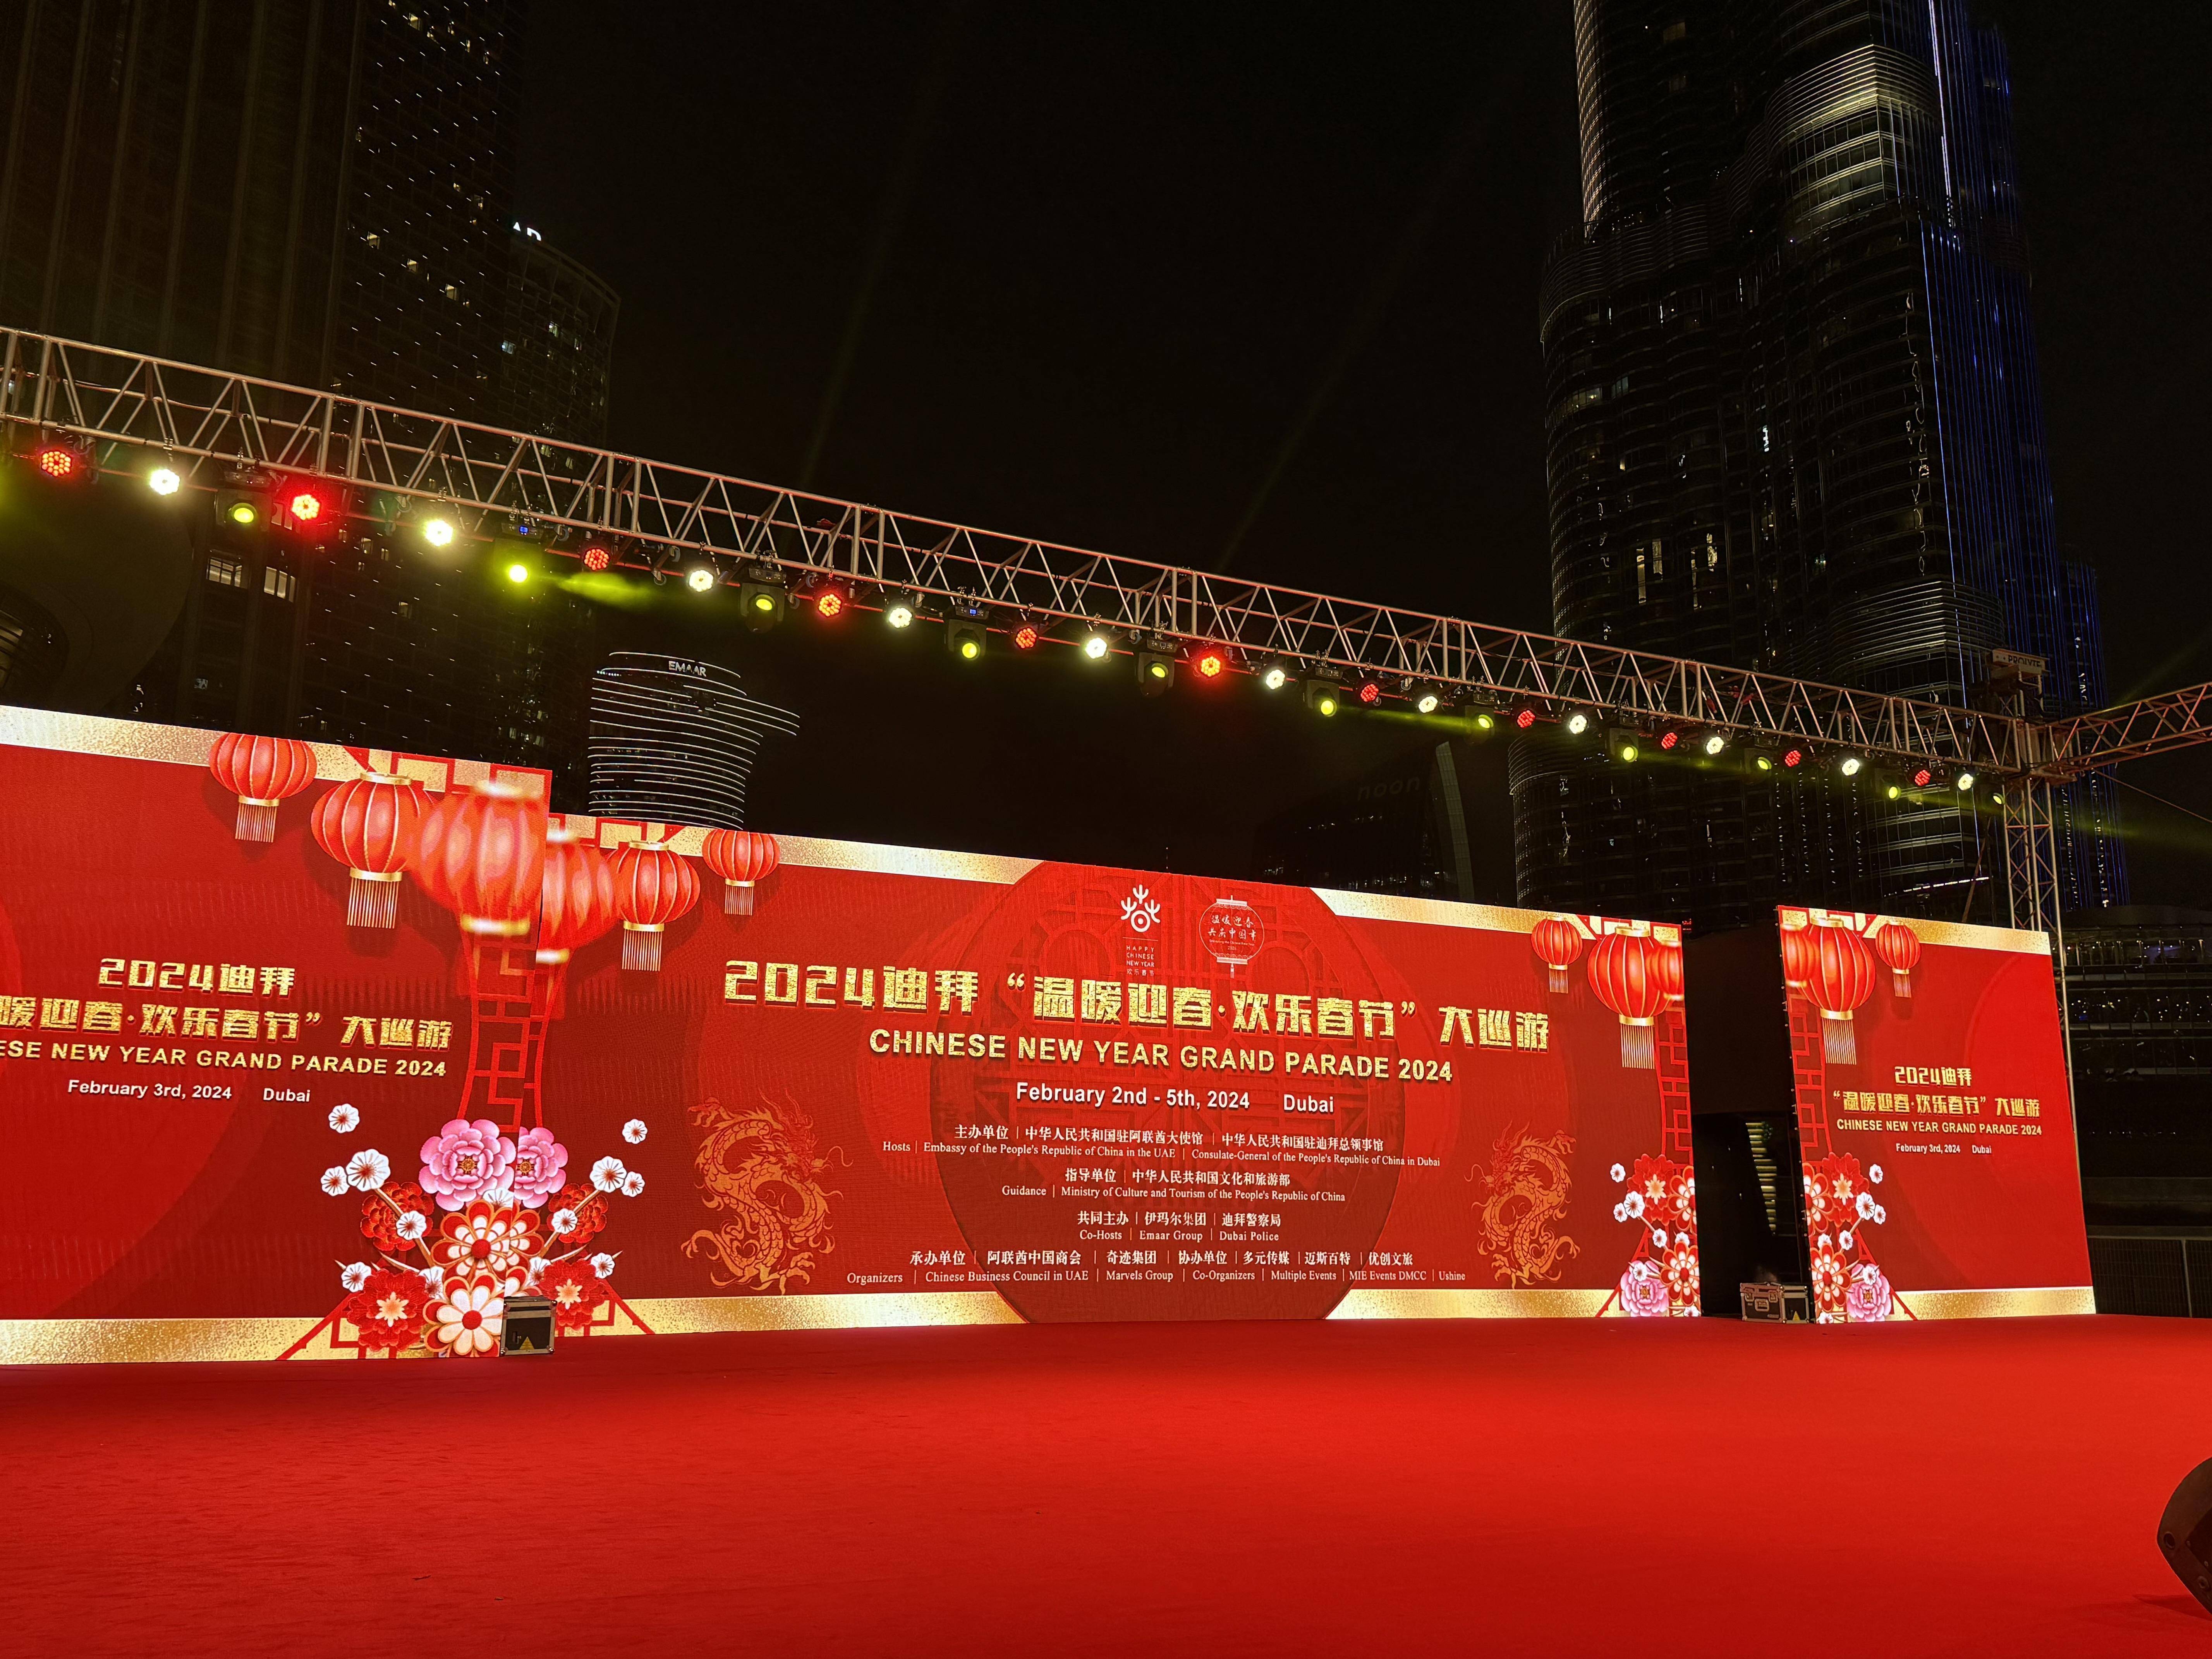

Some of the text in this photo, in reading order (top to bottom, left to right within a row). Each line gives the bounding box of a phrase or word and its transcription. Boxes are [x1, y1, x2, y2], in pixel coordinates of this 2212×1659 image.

[669, 661, 706, 677] EMAAR
[1358, 777, 1420, 800] noon
[99, 958, 295, 995] 2024迪拜
[725, 960, 1549, 1051] 2024迪拜 “温暖迎春·欢乐春节” 大巡游
[341, 1016, 452, 1049] 大巡游
[52, 1043, 110, 1060] NEW
[120, 1046, 186, 1064] YEAR
[197, 1050, 281, 1068] GRAND
[292, 1055, 387, 1073] PARADE
[395, 1060, 446, 1076] 2024
[870, 1029, 1452, 1081] CHINESE NEW YEAR GRAND PARADE 2024
[1895, 1066, 1972, 1086] 2024迪拜
[68, 1080, 310, 1101] February 3rd, 2024 Dubai
[1017, 1082, 1105, 1107] February
[1112, 1086, 1146, 1104] 2nd
[1167, 1089, 1200, 1109] 5th,
[1207, 1091, 1249, 1108] 2024
[1284, 1094, 1333, 1112] Dubai
[1834, 1091, 2040, 1117] “温暖迎春·欢乐春节” 大巡游
[1837, 1119, 2042, 1135] CHINESE NEW YEAR GRAND PARADE 2024
[955, 1125, 1383, 1152] 主办单位 中华人民共和国驻阿联酋大使馆 中华人民共和国驻迪拜总领事馆
[1896, 1143, 1927, 1154] February
[1929, 1144, 1942, 1154] 3rd,
[1972, 1145, 1991, 1153] Dubai
[883, 1142, 1439, 1166] Hosts Embassy of the People's Republic of China in the UAE Consulate-General of the People's Republic of China in Dubai
[1065, 1168, 1290, 1186] 指导单位 中华人民共和国文化和旅游部
[1002, 1186, 1345, 1202] Guidance Ministry of Culture and Tourism of the People's Republic of China
[1078, 1211, 1280, 1227] 共同主办 伊玛尔集团 迪拜警察局
[1080, 1230, 1278, 1243] Co-Hosts Emaar Group Dubai Police
[910, 1250, 1413, 1266] 承办单位 阿联酋中国商会 奇迹集团 协办单位 多元传媒 迈斯百特 优创文旅
[847, 1270, 1465, 1285] Organizers Chinese Business Council in UAE Marvels Group Co-Organizers Multiple Events MIE Events DMCC Ushine
